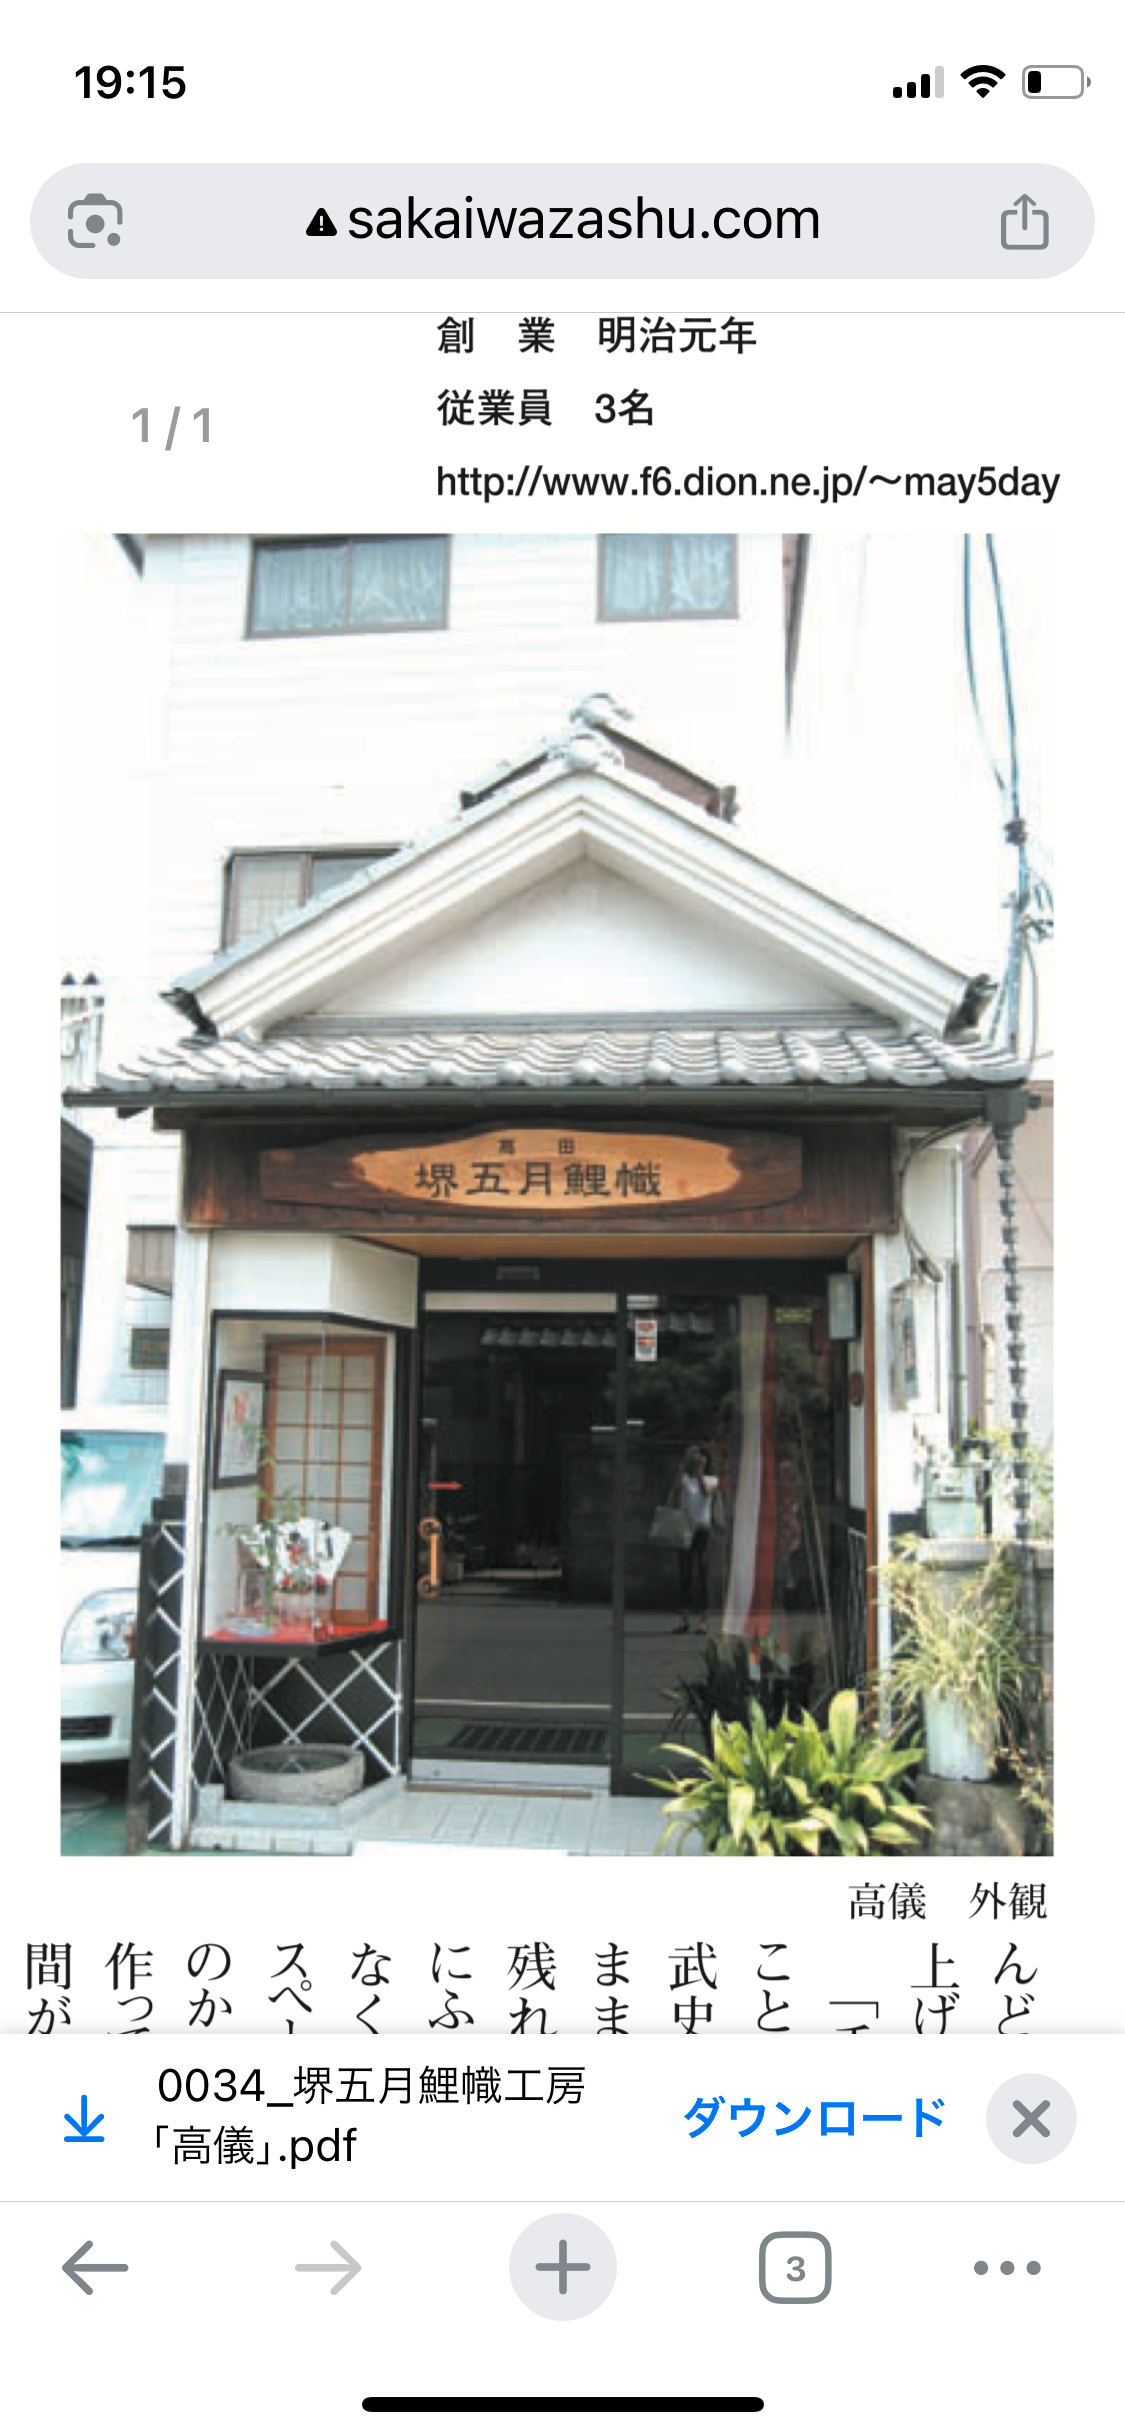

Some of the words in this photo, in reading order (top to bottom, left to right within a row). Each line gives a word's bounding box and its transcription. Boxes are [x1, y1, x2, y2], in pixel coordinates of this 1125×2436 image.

[76, 65, 186, 99] 19:15
[349, 196, 819, 239] sakaiwazashu.com
[598, 316, 757, 354] 明治元年
[437, 389, 552, 427] 従業員
[595, 388, 653, 427] 3名
[415, 1161, 662, 1198] 堺五月鯉幟
[849, 1882, 927, 1921] 高儀
[969, 1882, 1048, 1921] 外観
[105, 1942, 153, 2034] 作っ
[188, 1944, 232, 2028] のか
[429, 1943, 474, 2030] にふ
[757, 1944, 790, 2033] こと
[159, 2065, 586, 2108] 0034_堺五月鯉幟工房
[684, 2096, 946, 2138] ダウンロード
[156, 2125, 358, 2170] 「高儀」.pdf
[787, 2256, 806, 2282] 3
